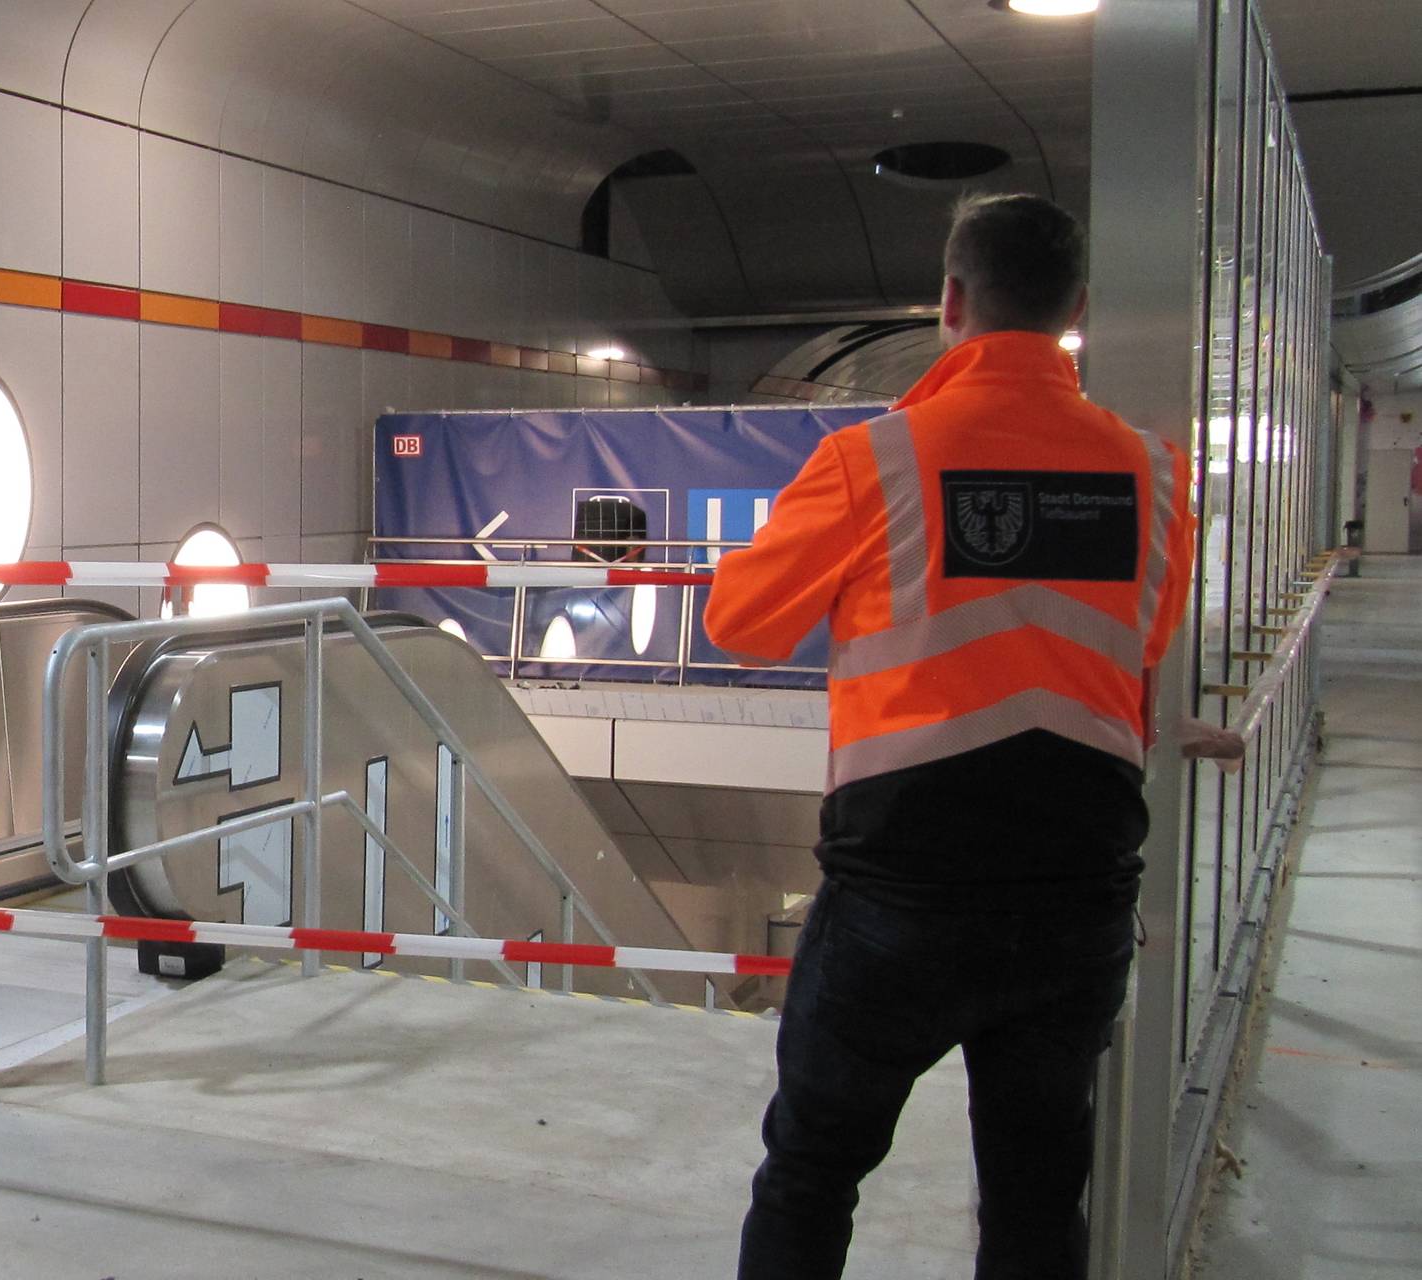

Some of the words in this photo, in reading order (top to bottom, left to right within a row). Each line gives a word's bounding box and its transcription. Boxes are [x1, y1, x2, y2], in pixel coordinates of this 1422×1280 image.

[396, 436, 418, 453] DB
[1038, 492, 1070, 505] Stadt
[1073, 492, 1133, 506] Dortmund
